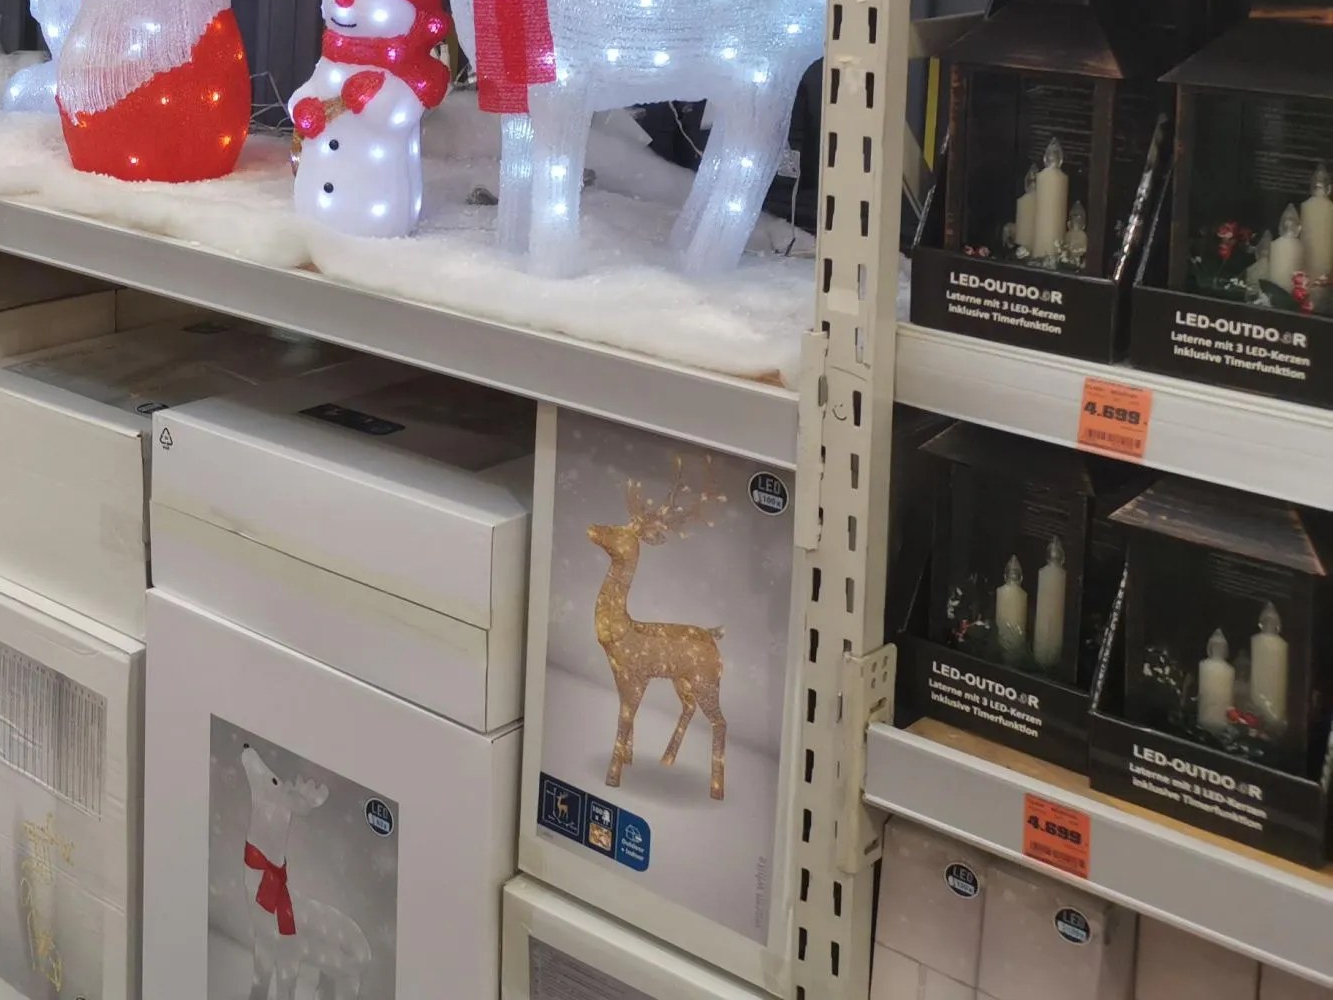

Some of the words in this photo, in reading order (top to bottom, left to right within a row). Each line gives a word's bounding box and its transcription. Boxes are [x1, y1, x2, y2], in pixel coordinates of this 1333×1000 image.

[946, 290, 982, 305] Laterne
[983, 298, 1000, 309] mit
[1002, 301, 1009, 310] 3
[1010, 302, 1065, 322] LED-Kerzen
[992, 311, 1062, 335] Timerfunktion
[1171, 331, 1212, 347] Laterne
[1214, 339, 1234, 352] mit
[1236, 343, 1243, 353] 3
[1245, 344, 1311, 366] LED-Kerzen
[1224, 354, 1306, 380] Timerfunktion
[758, 476, 781, 496] LED
[929, 678, 963, 697] Laterne
[965, 691, 980, 704] mit
[981, 696, 988, 706] 3
[990, 699, 1043, 726] LED-Kerzen
[972, 703, 1039, 738] Timerfunktion
[953, 866, 974, 884] LED
